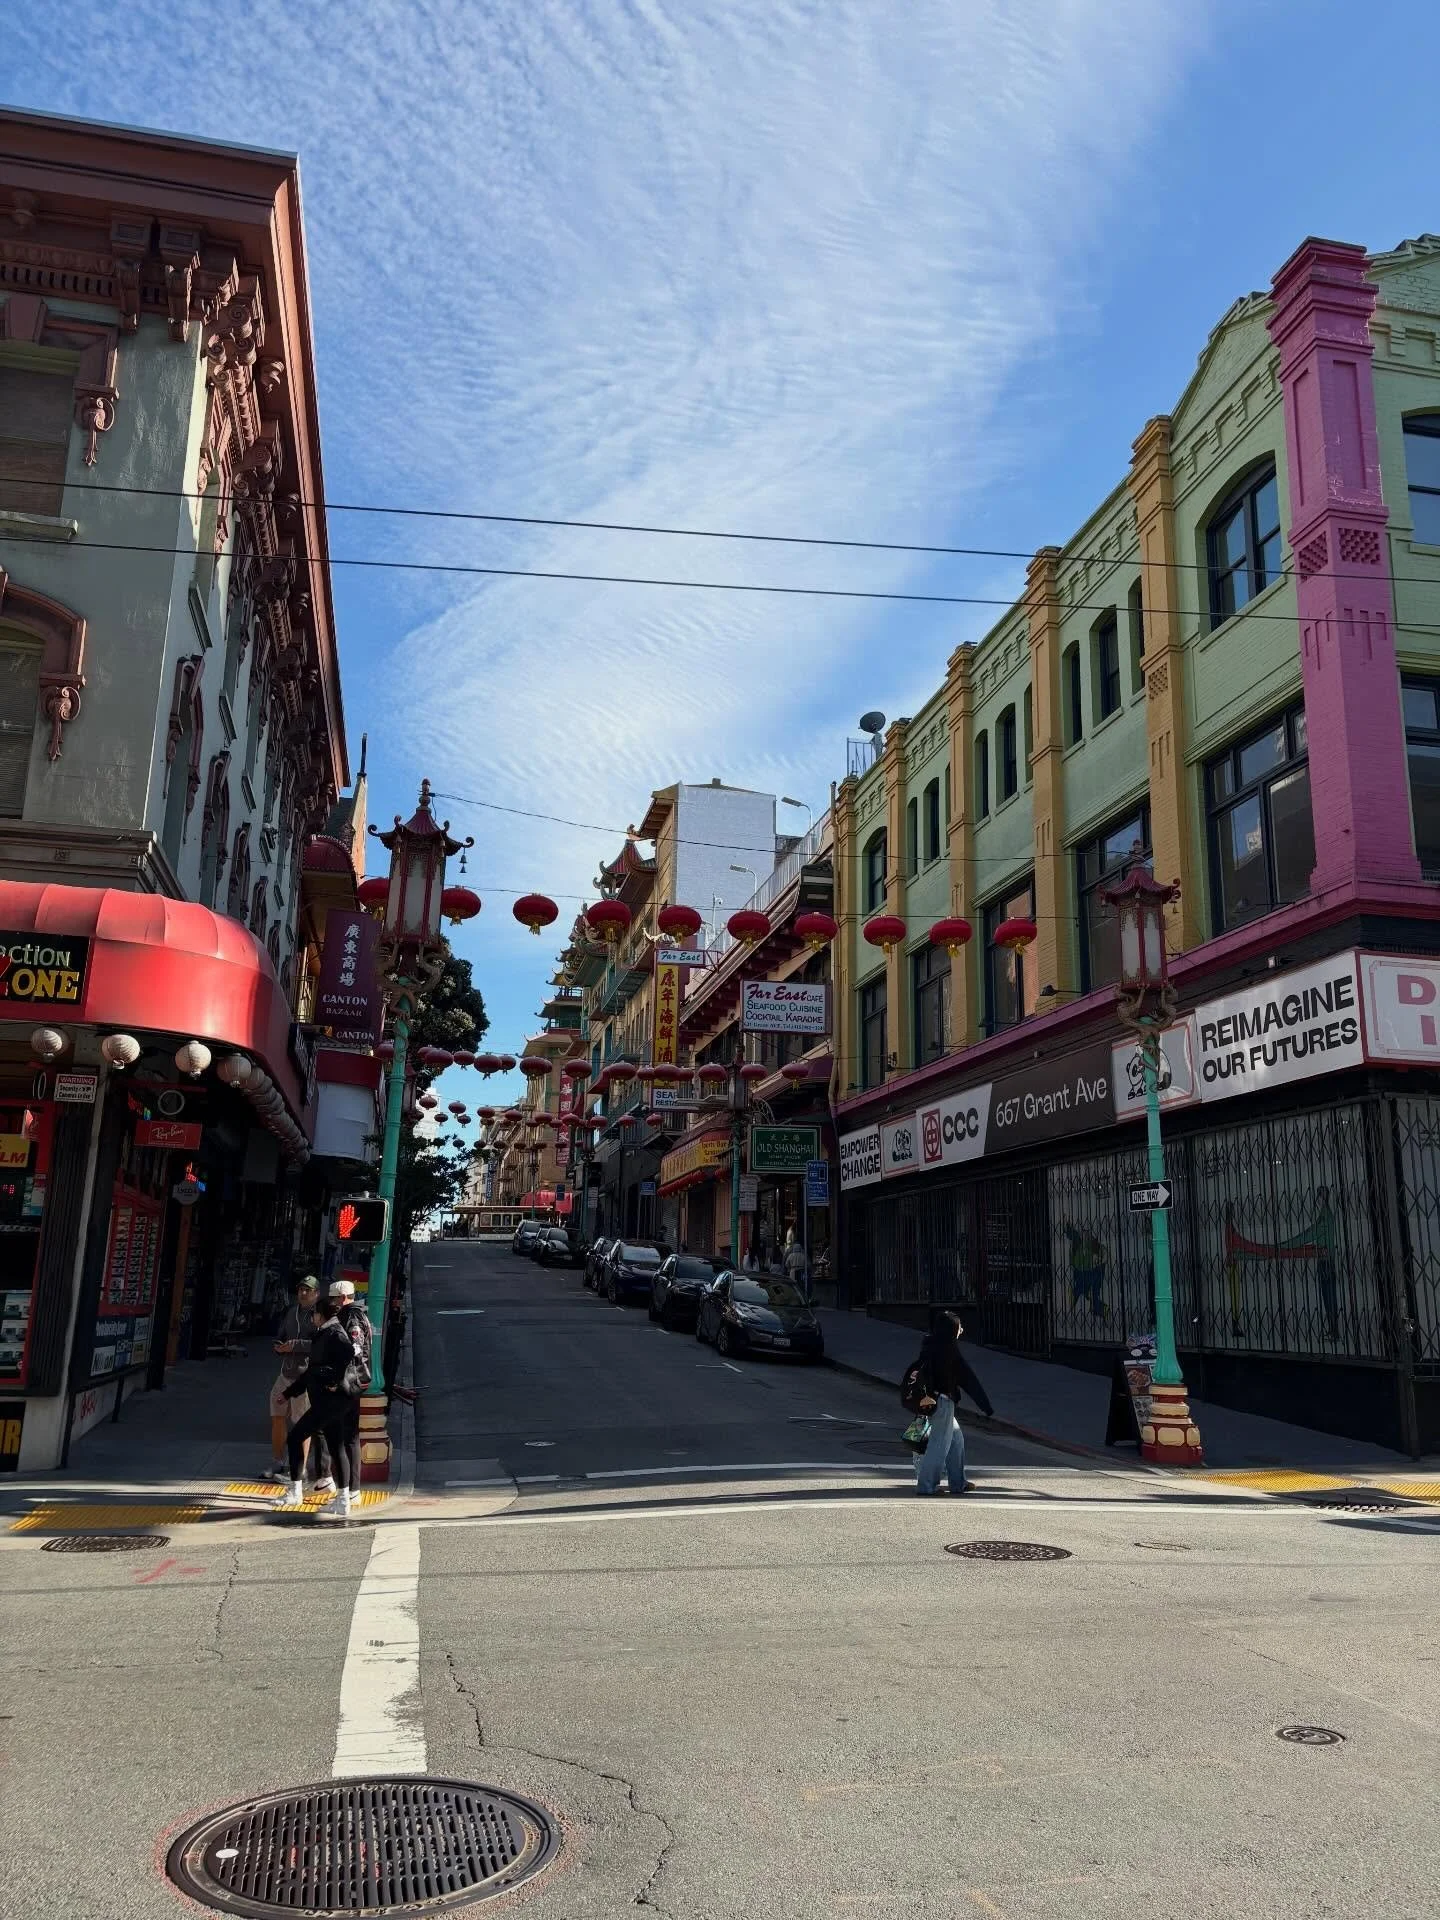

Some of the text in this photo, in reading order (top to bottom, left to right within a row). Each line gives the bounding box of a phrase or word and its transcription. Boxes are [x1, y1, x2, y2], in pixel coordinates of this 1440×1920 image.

[660, 951, 701, 961] Far East
[12, 968, 80, 1000] ONE
[746, 983, 772, 1000] Far
[773, 985, 808, 1001] East
[322, 993, 369, 1006] CANTON
[747, 999, 823, 1014] SEAFOOD CUISINE
[326, 1006, 363, 1018] BAZAAR
[745, 1010, 823, 1024] COCKTAIL KARAOKE
[1200, 975, 1355, 1052] REIMAGINE
[336, 1030, 375, 1042] CANTON
[659, 968, 675, 1087] 康年海鮮酒
[1202, 1017, 1358, 1083] OUR FUTURES
[995, 1076, 1107, 1128] 667 Grant Ave
[942, 1107, 979, 1145] CCC
[757, 1143, 815, 1154] OLD SHANGHAI
[840, 1133, 881, 1160] EMPOWER
[841, 1153, 881, 1181] CHANGE
[1133, 1190, 1159, 1203] ONE WAY
